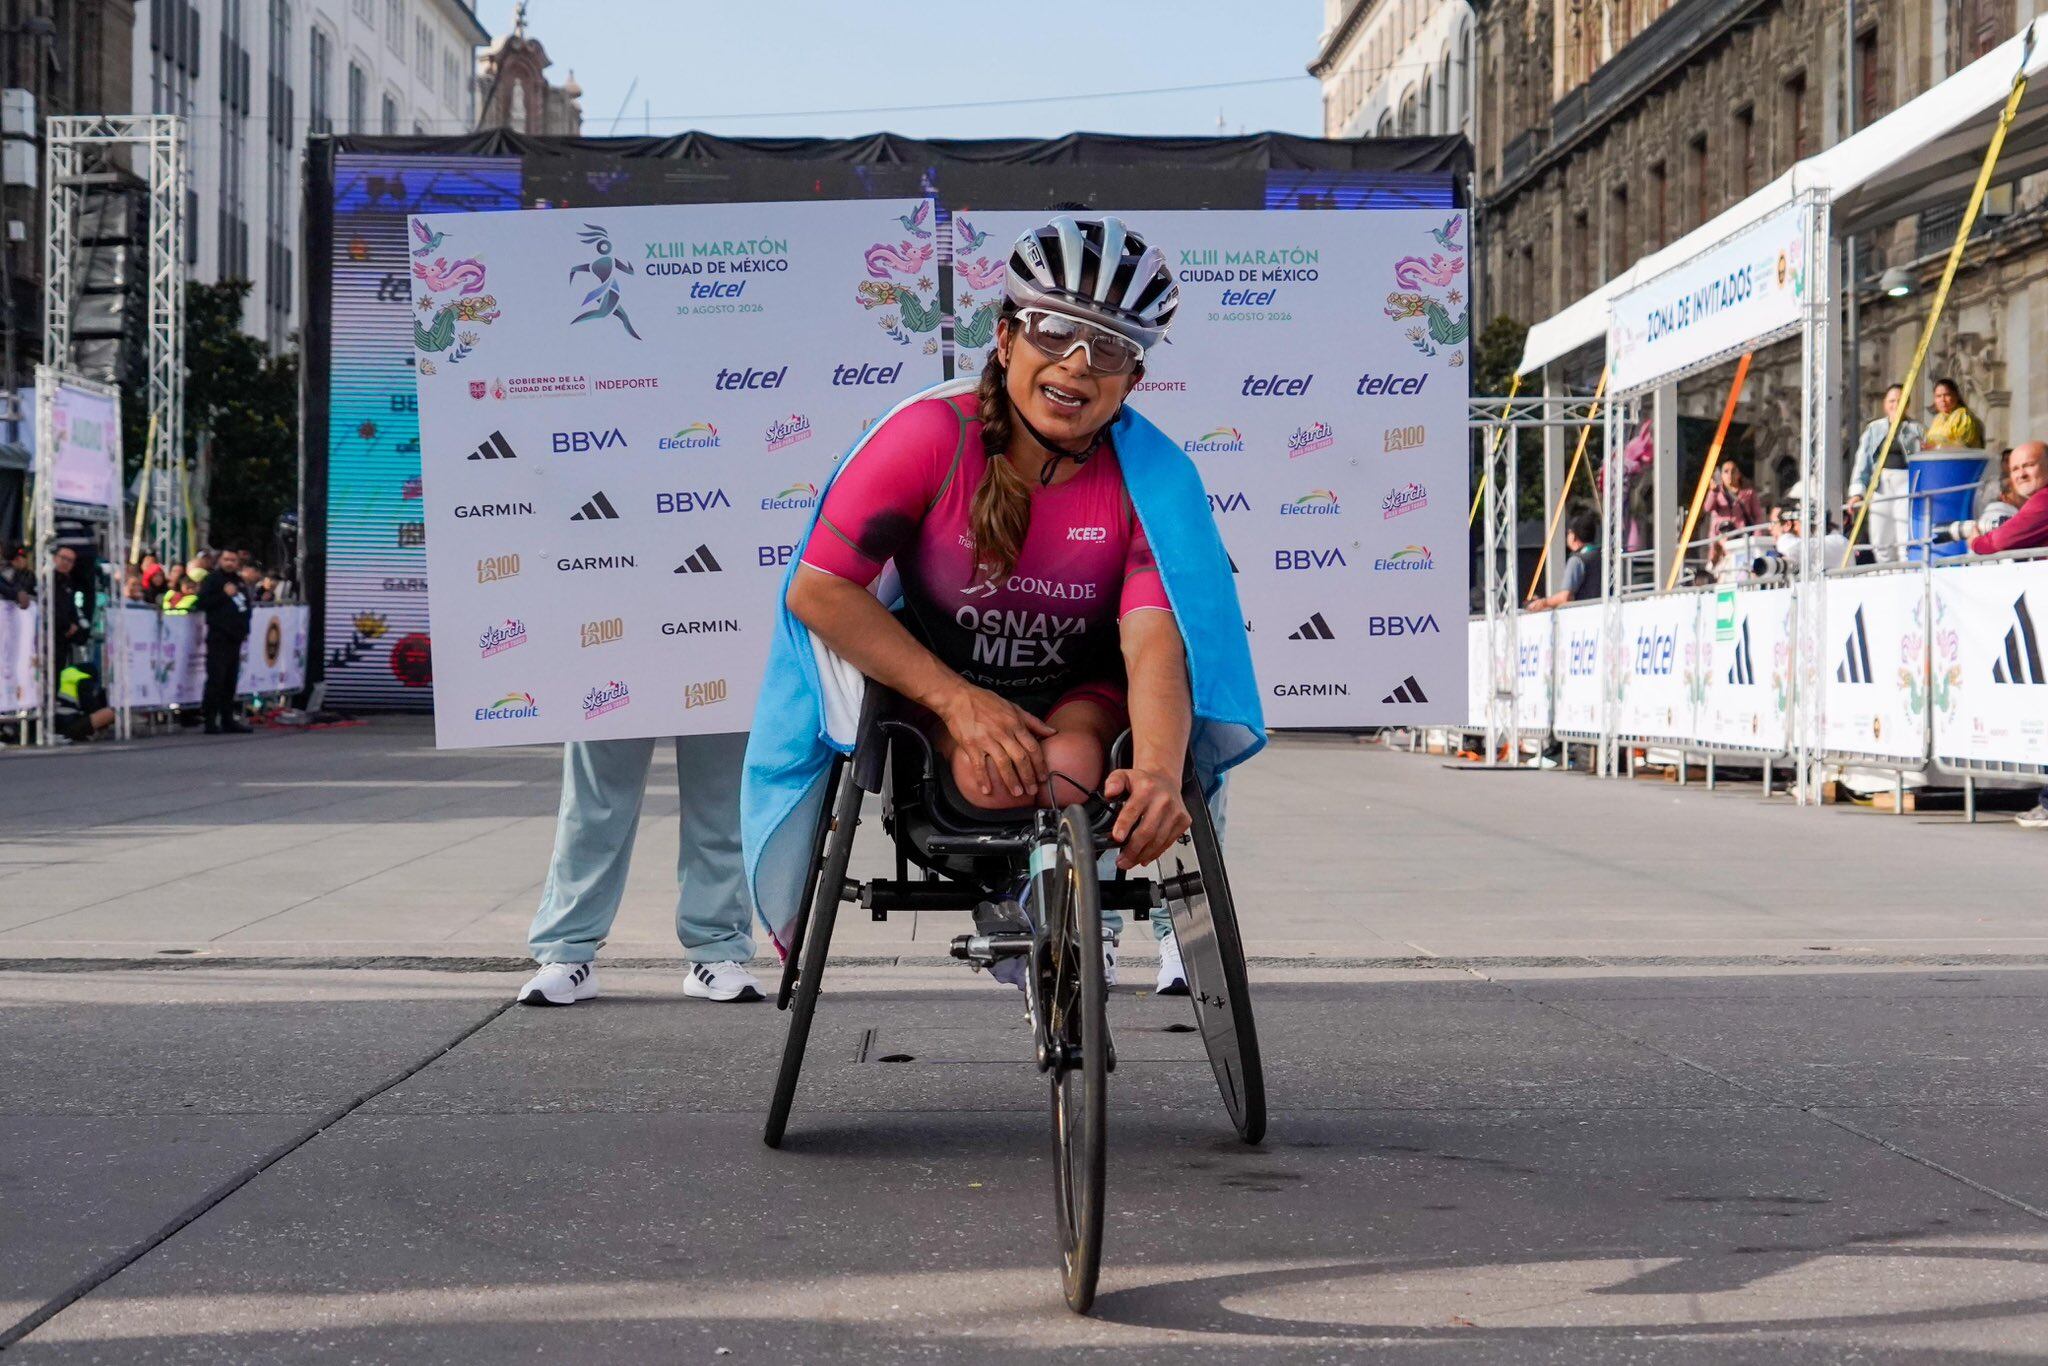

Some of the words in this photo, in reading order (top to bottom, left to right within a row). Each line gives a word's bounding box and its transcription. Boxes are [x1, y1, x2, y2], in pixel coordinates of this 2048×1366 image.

[645, 242, 685, 259] XLIII
[692, 235, 788, 257] MARATÓN
[1180, 249, 1218, 265] XLIII
[1225, 246, 1319, 265] MARATÓN
[646, 262, 703, 276] CIUDAD
[707, 261, 727, 274] DE
[730, 258, 789, 273] MÉXICO
[1179, 269, 1235, 283] CIUDAD
[1239, 269, 1258, 282] DE
[1262, 266, 1319, 282] MÉXICO
[690, 280, 747, 299] telcel
[1221, 288, 1277, 306] telcel
[676, 306, 689, 315] 30
[692, 304, 736, 315] AGOSTO
[739, 303, 764, 313] 2026
[1647, 304, 1674, 343] ZONA
[1677, 295, 1690, 330] DE
[1693, 264, 1752, 323] INVITADOS
[1208, 312, 1220, 321] 30
[1222, 312, 1264, 321] AGOSTO
[1268, 312, 1292, 321] 2026
[508, 377, 556, 385] GOBIERNO
[715, 366, 788, 391] telcel
[832, 362, 904, 386] telcel
[555, 383, 586, 391] MÉXICO
[595, 378, 659, 391] INDEPORTE
[1133, 382, 1187, 391] DEPORTE
[1241, 374, 1314, 397] telcel
[1356, 373, 1429, 396] telcel
[552, 428, 628, 453] BBVA
[659, 436, 721, 450] Electrolit
[1184, 440, 1245, 452] Electrolit
[656, 488, 731, 514] BBVA
[761, 497, 818, 510] Electroli
[1280, 503, 1341, 515] Electrolit
[1066, 526, 1107, 541] XCEED
[758, 545, 800, 566] BB
[1275, 547, 1347, 570] BBVA
[1374, 558, 1435, 571] Electrolit
[1006, 575, 1097, 600] CONADE
[955, 605, 1087, 639] OSNAYA
[1369, 614, 1440, 636] BBVA
[972, 633, 1066, 668] MEX
[1636, 623, 1678, 675] telcel
[475, 706, 539, 721] Electrolit
